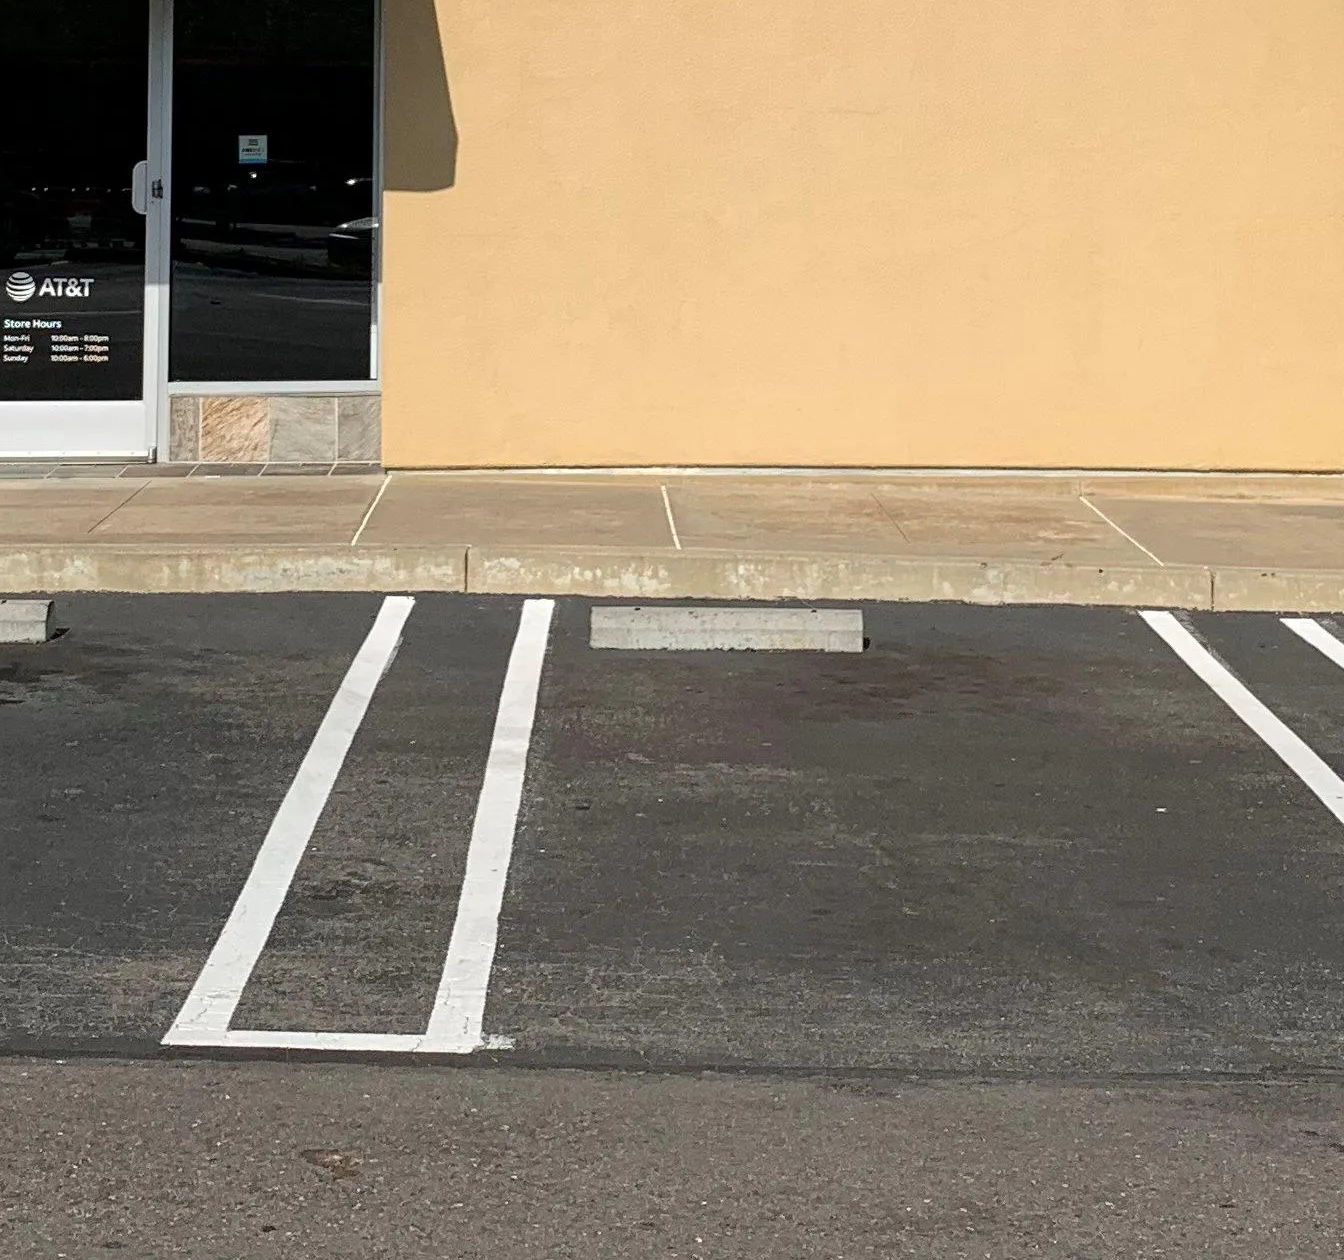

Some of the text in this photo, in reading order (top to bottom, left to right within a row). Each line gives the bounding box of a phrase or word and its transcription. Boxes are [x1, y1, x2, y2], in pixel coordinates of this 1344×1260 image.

[38, 277, 95, 297] AT&T
[3, 319, 62, 329] Store Hours
[3, 344, 35, 353] Saturday
[2, 354, 29, 363] Sunday
